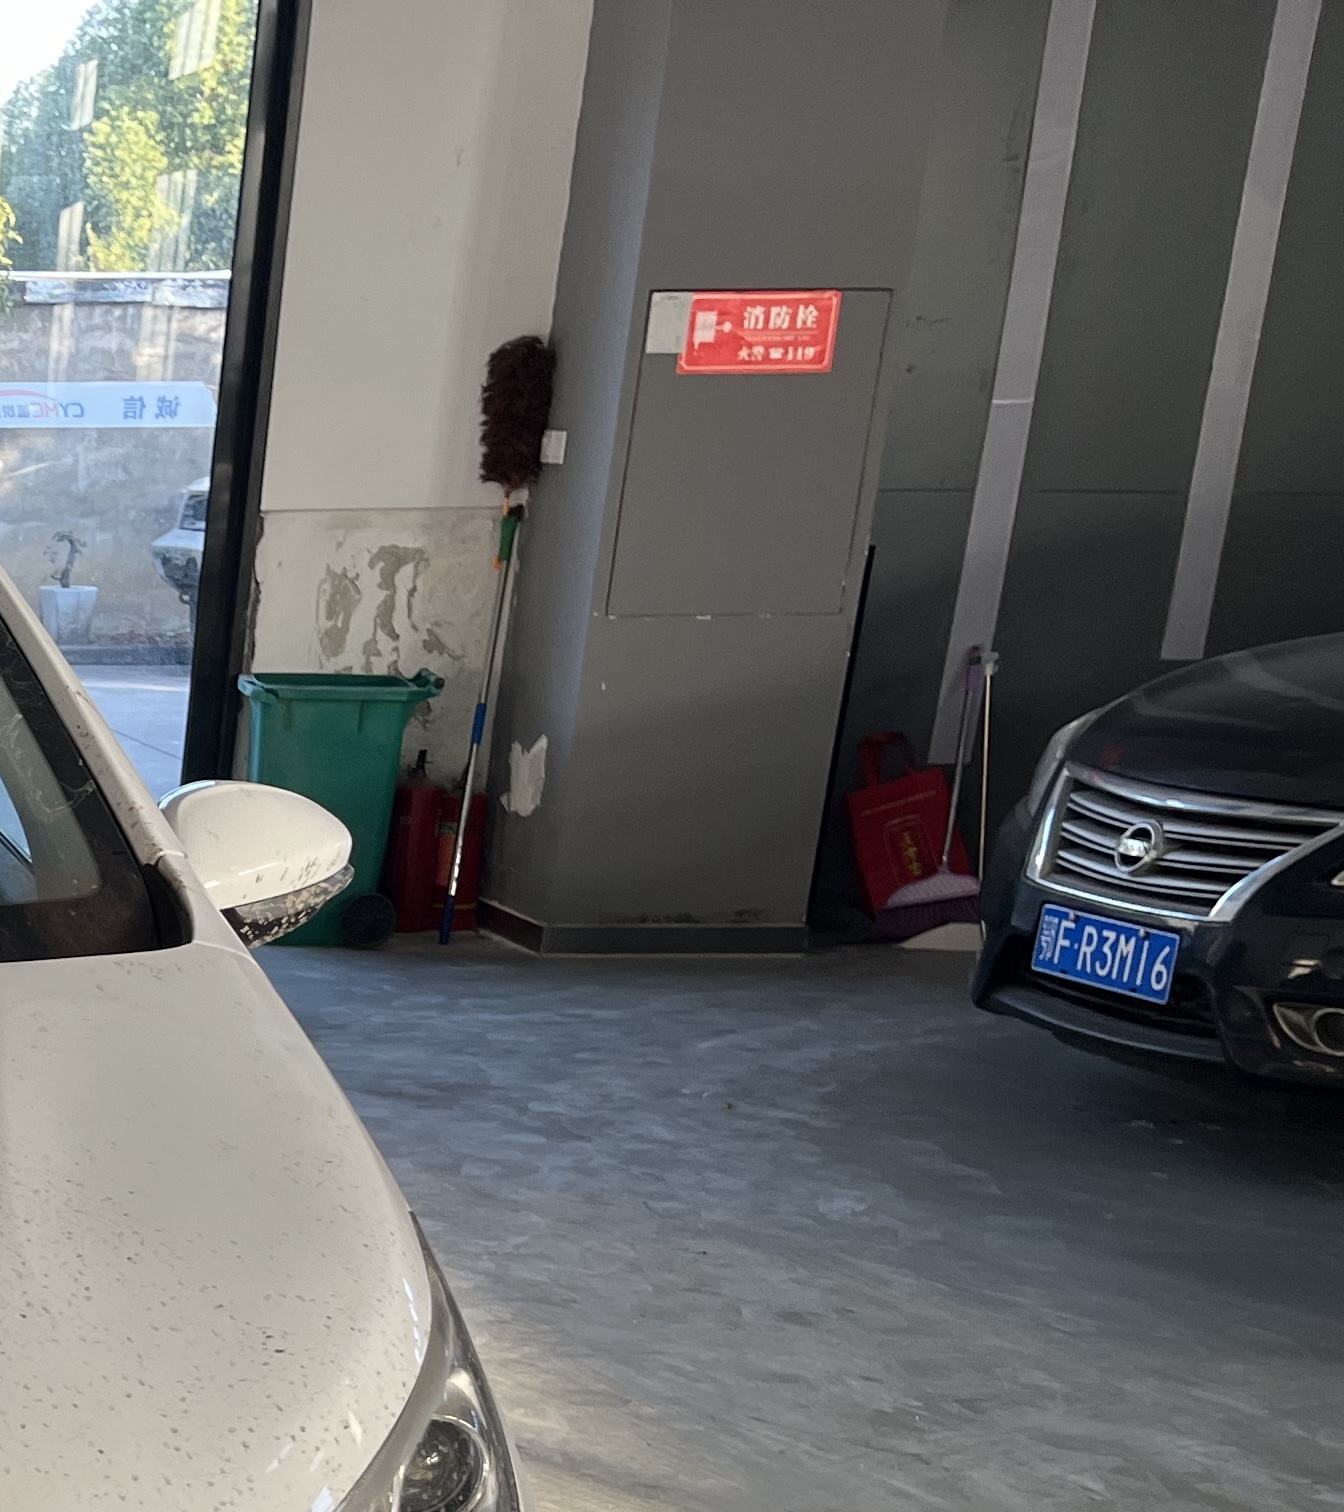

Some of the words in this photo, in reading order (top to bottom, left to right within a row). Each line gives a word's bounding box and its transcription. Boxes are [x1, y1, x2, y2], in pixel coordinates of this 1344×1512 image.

[743, 304, 819, 329] 消防栓
[787, 345, 815, 361] 119
